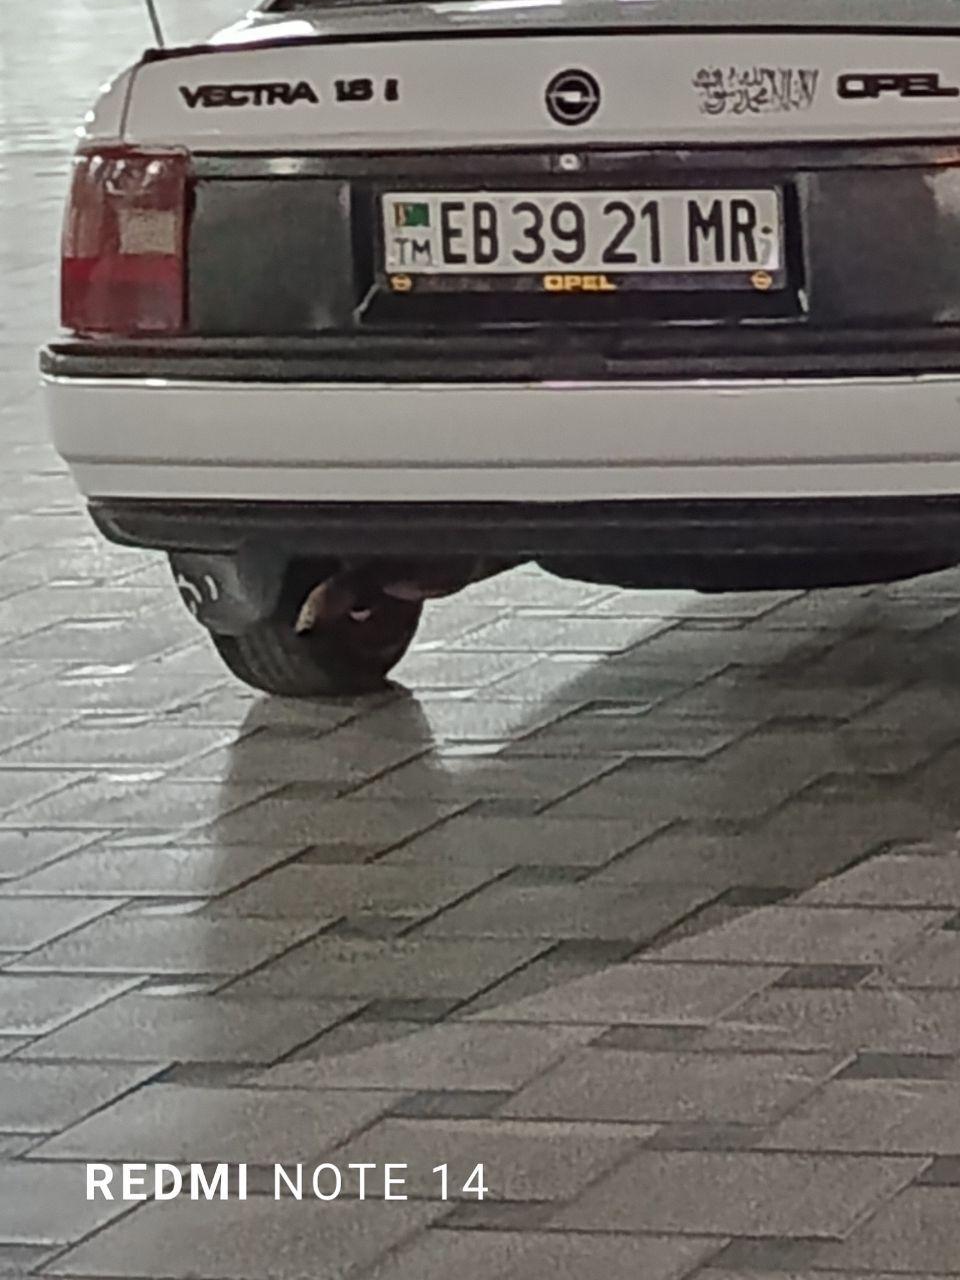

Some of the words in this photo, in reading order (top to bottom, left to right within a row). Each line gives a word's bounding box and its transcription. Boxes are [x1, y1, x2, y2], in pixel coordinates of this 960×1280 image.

[179, 81, 319, 108] VECTRA
[837, 73, 960, 99] OPEL
[440, 201, 499, 265] EB
[687, 199, 757, 263] MR
[393, 238, 432, 266] TM
[543, 274, 618, 291] OPEL
